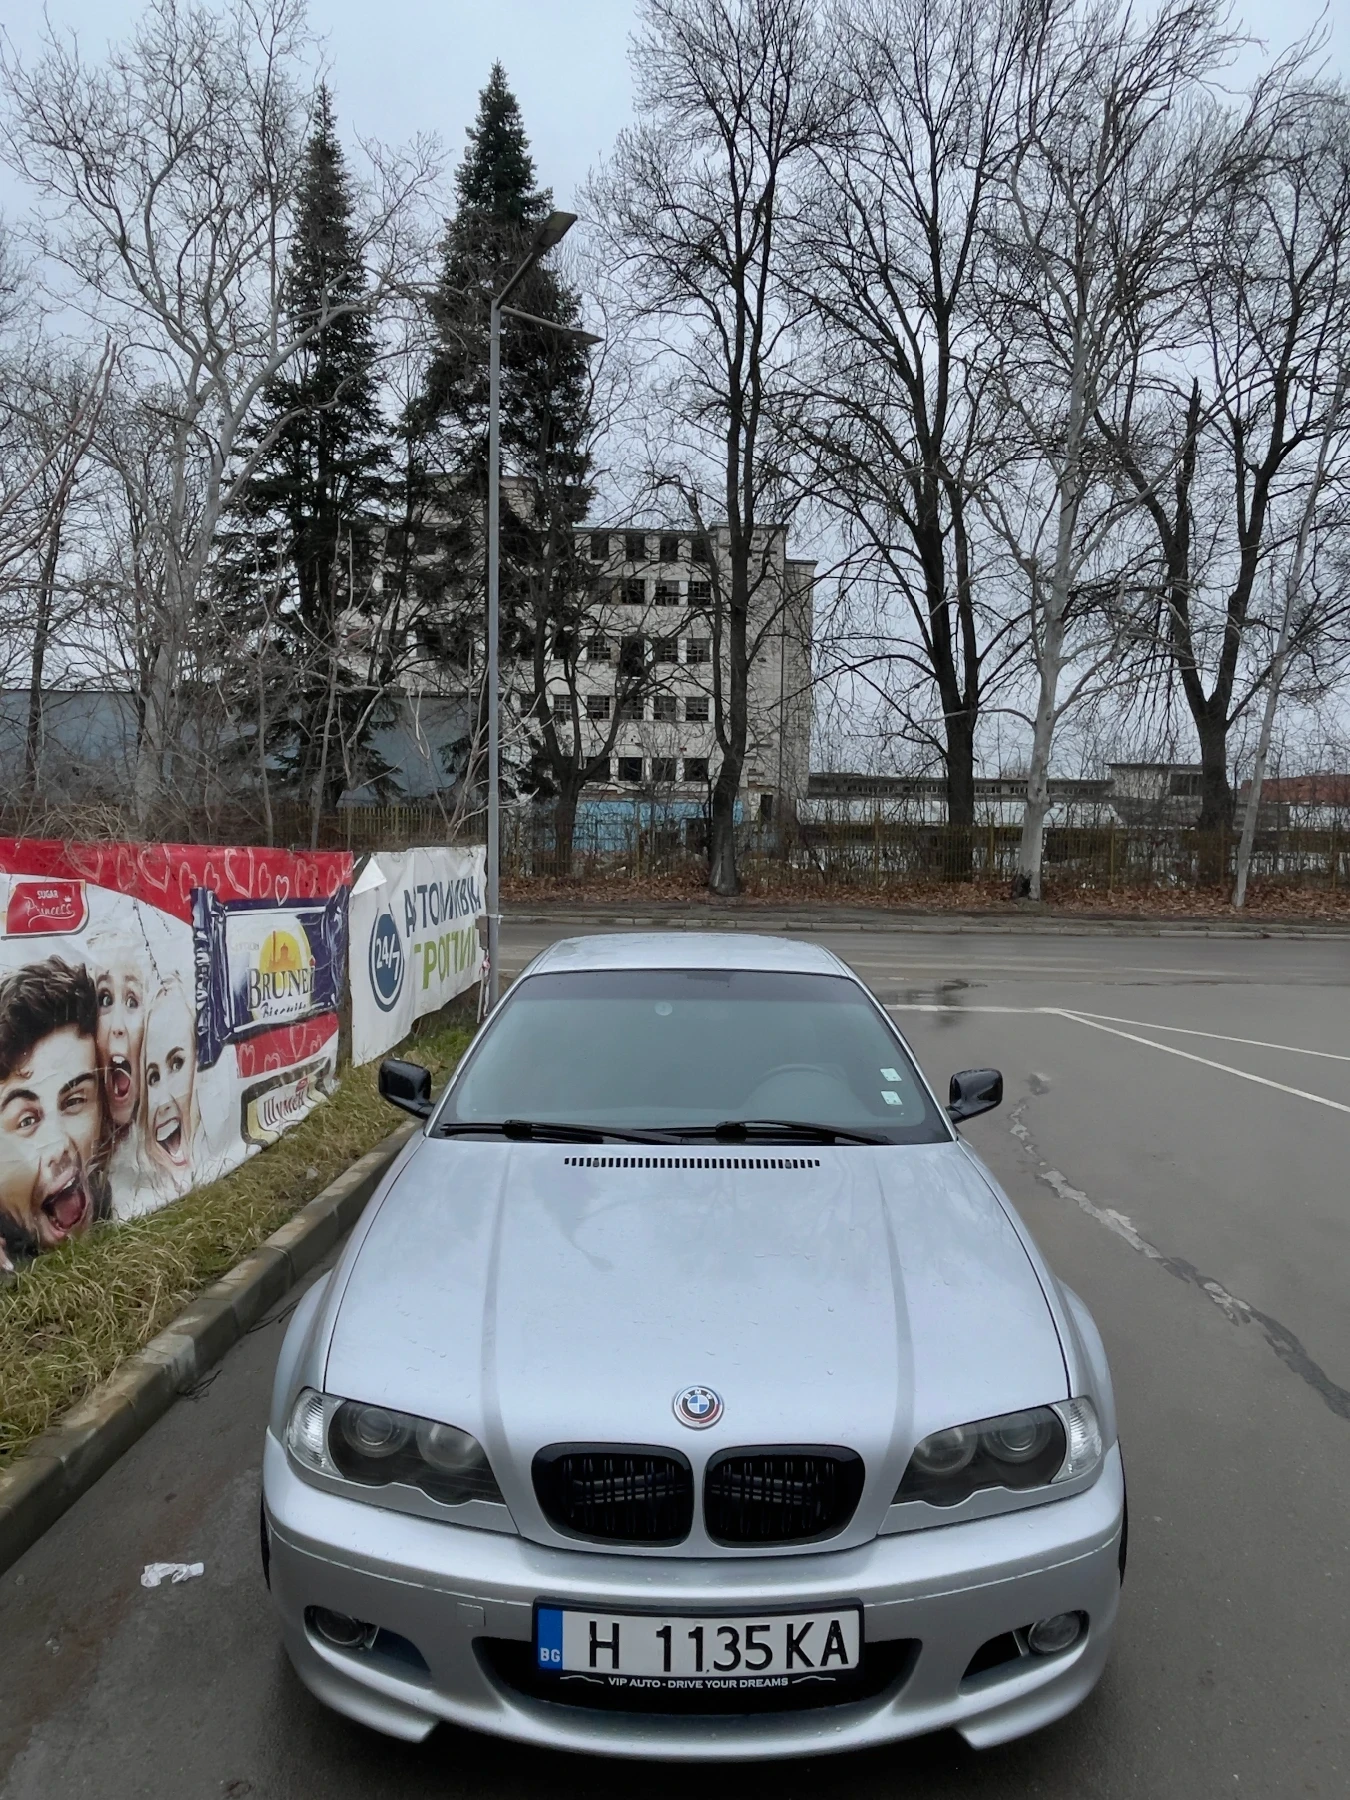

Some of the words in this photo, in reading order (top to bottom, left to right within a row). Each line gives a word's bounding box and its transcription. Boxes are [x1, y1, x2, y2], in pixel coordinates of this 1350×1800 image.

[23, 896, 73, 917] Princess
[36, 889, 59, 900] SUGAR
[404, 876, 482, 938] АТОМИВКА
[376, 934, 400, 981] 24/7
[247, 958, 316, 1012] BRUNEI
[540, 1648, 561, 1663] BG
[588, 1620, 620, 1670] H
[656, 1624, 774, 1673] 1135
[786, 1619, 850, 1670] KA
[608, 1677, 628, 1687] VIP
[629, 1678, 661, 1688] AUTO
[667, 1679, 704, 1689] DRIVE
[705, 1679, 738, 1689] YOUR
[739, 1677, 789, 1688] DREAMS
